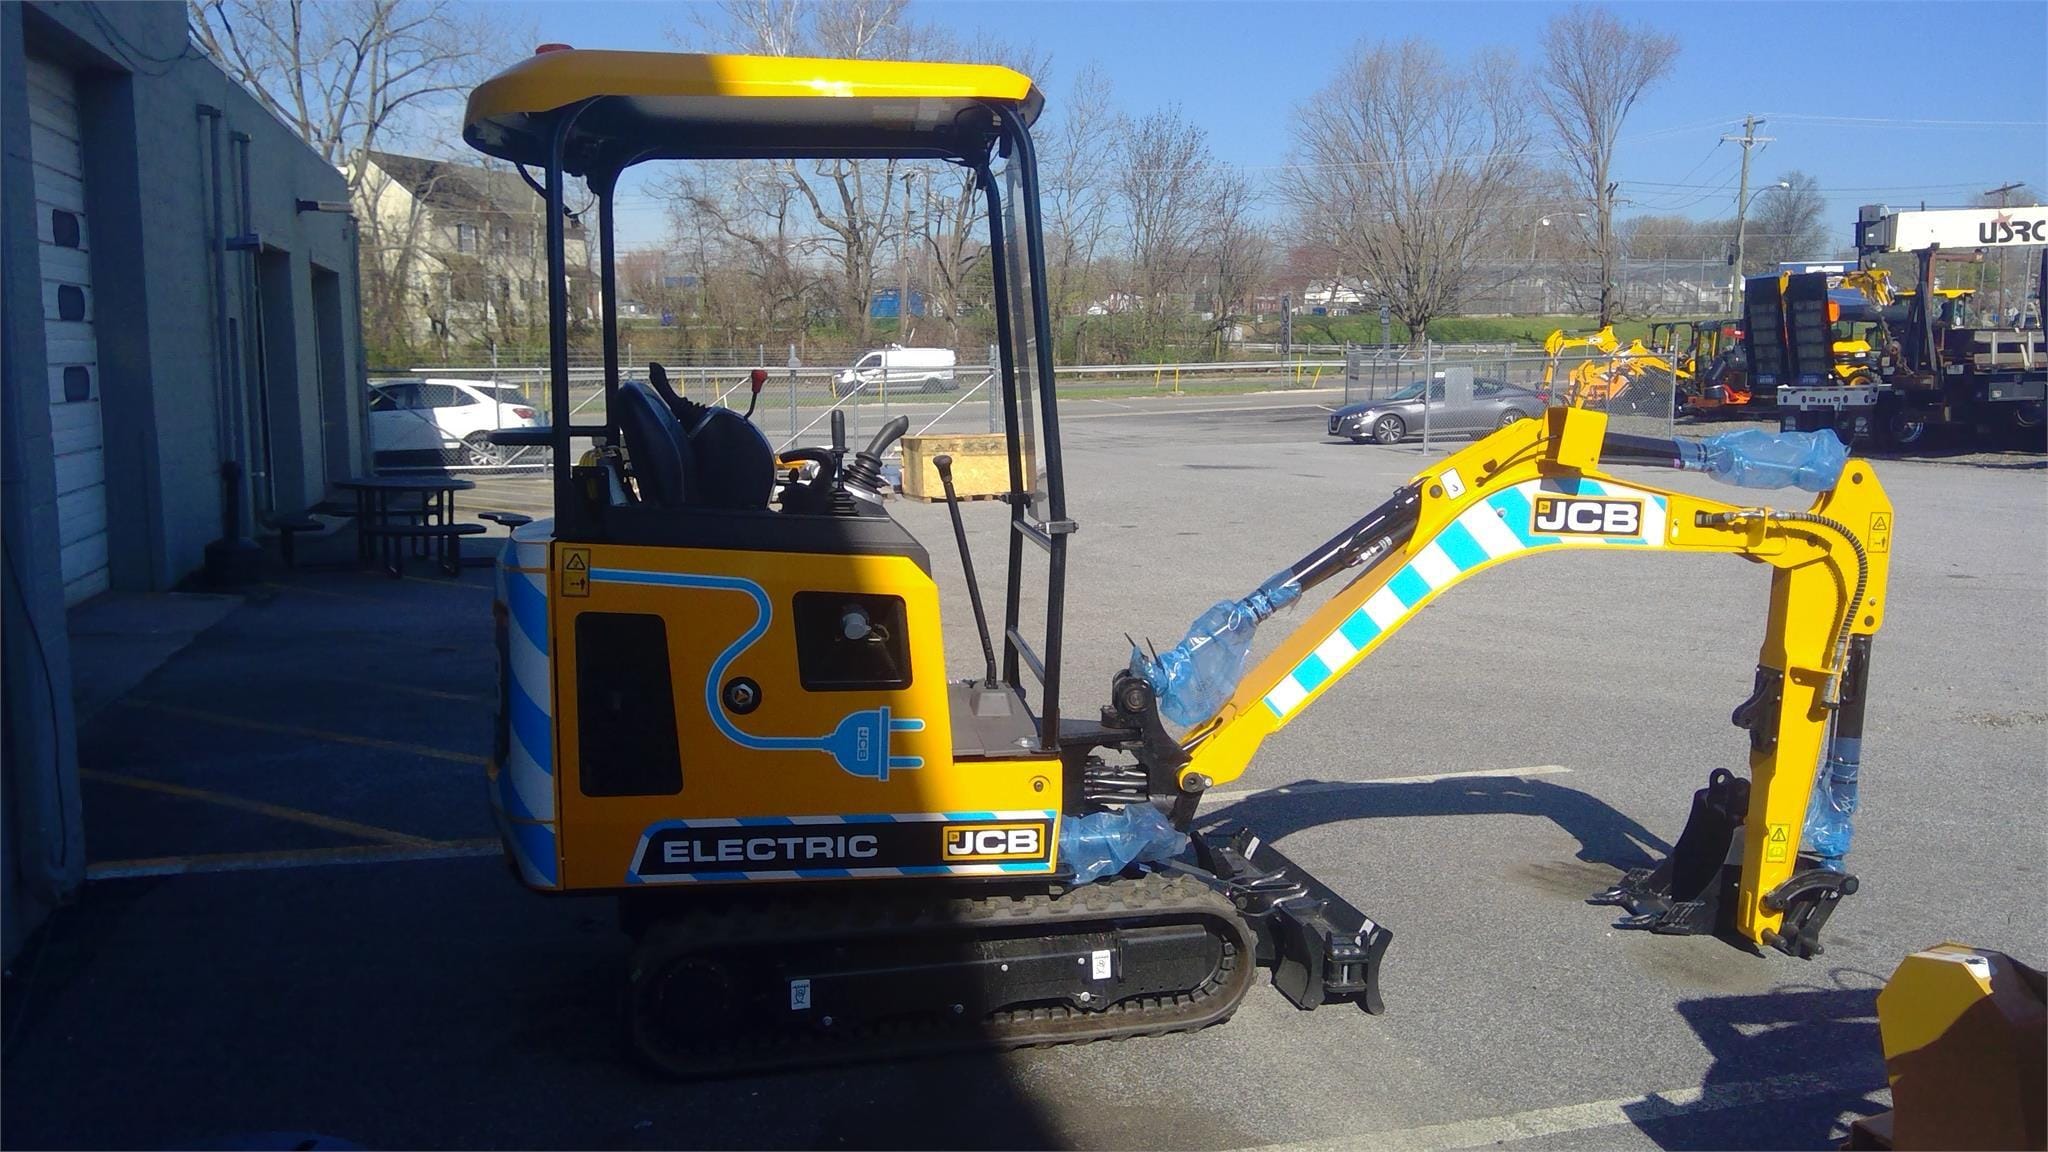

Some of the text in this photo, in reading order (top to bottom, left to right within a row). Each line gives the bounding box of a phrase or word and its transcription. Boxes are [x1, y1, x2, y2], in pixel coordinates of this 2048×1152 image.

[1979, 219, 2046, 243] USRC
[1537, 500, 1638, 533] JCB
[663, 829, 1038, 863] ELECTRIC JCB
